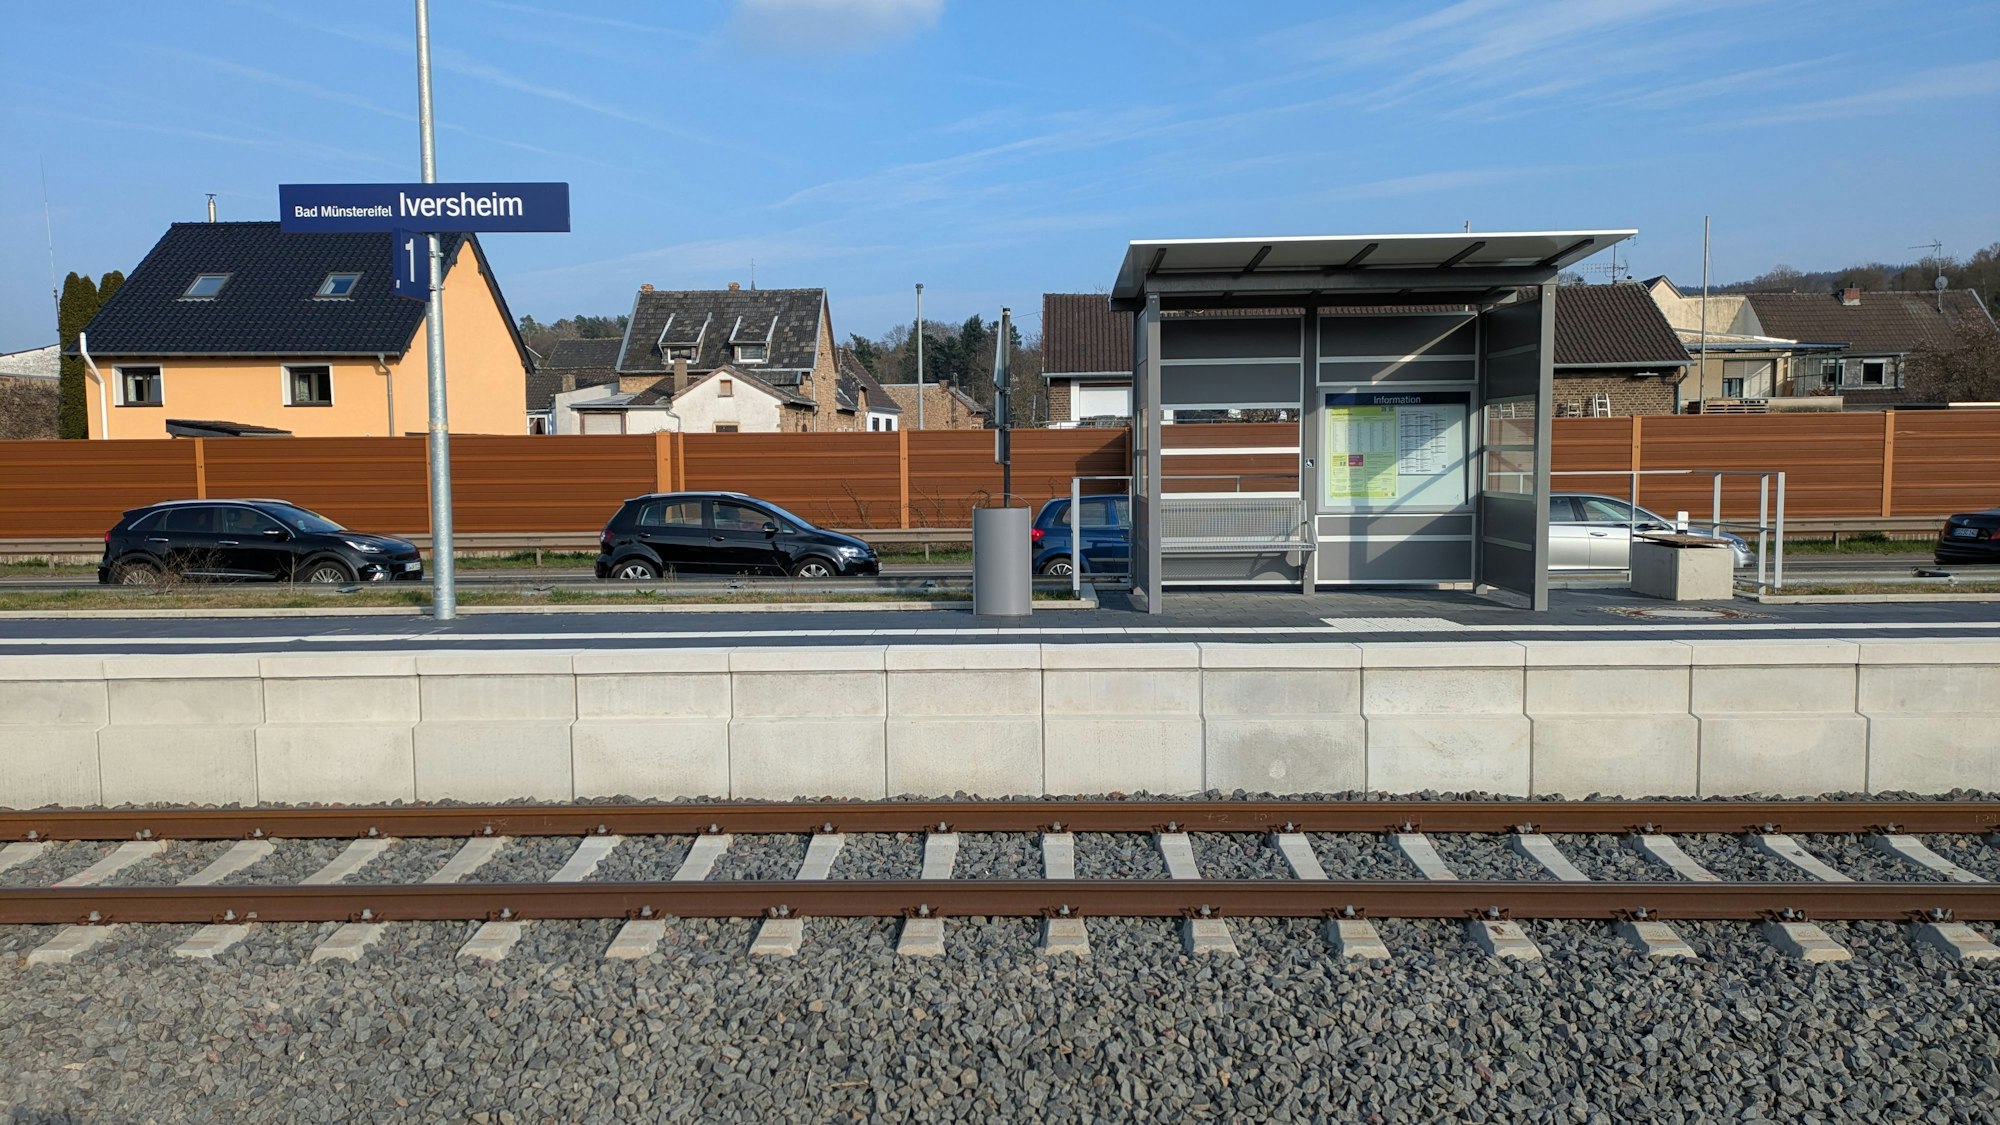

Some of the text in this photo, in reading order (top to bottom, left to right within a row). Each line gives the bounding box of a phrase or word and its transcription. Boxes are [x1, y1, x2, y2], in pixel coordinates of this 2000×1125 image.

[294, 191, 523, 217] Bad Münstereifel Iversheim
[405, 238, 415, 283] 1
[1373, 395, 1421, 404] Information
